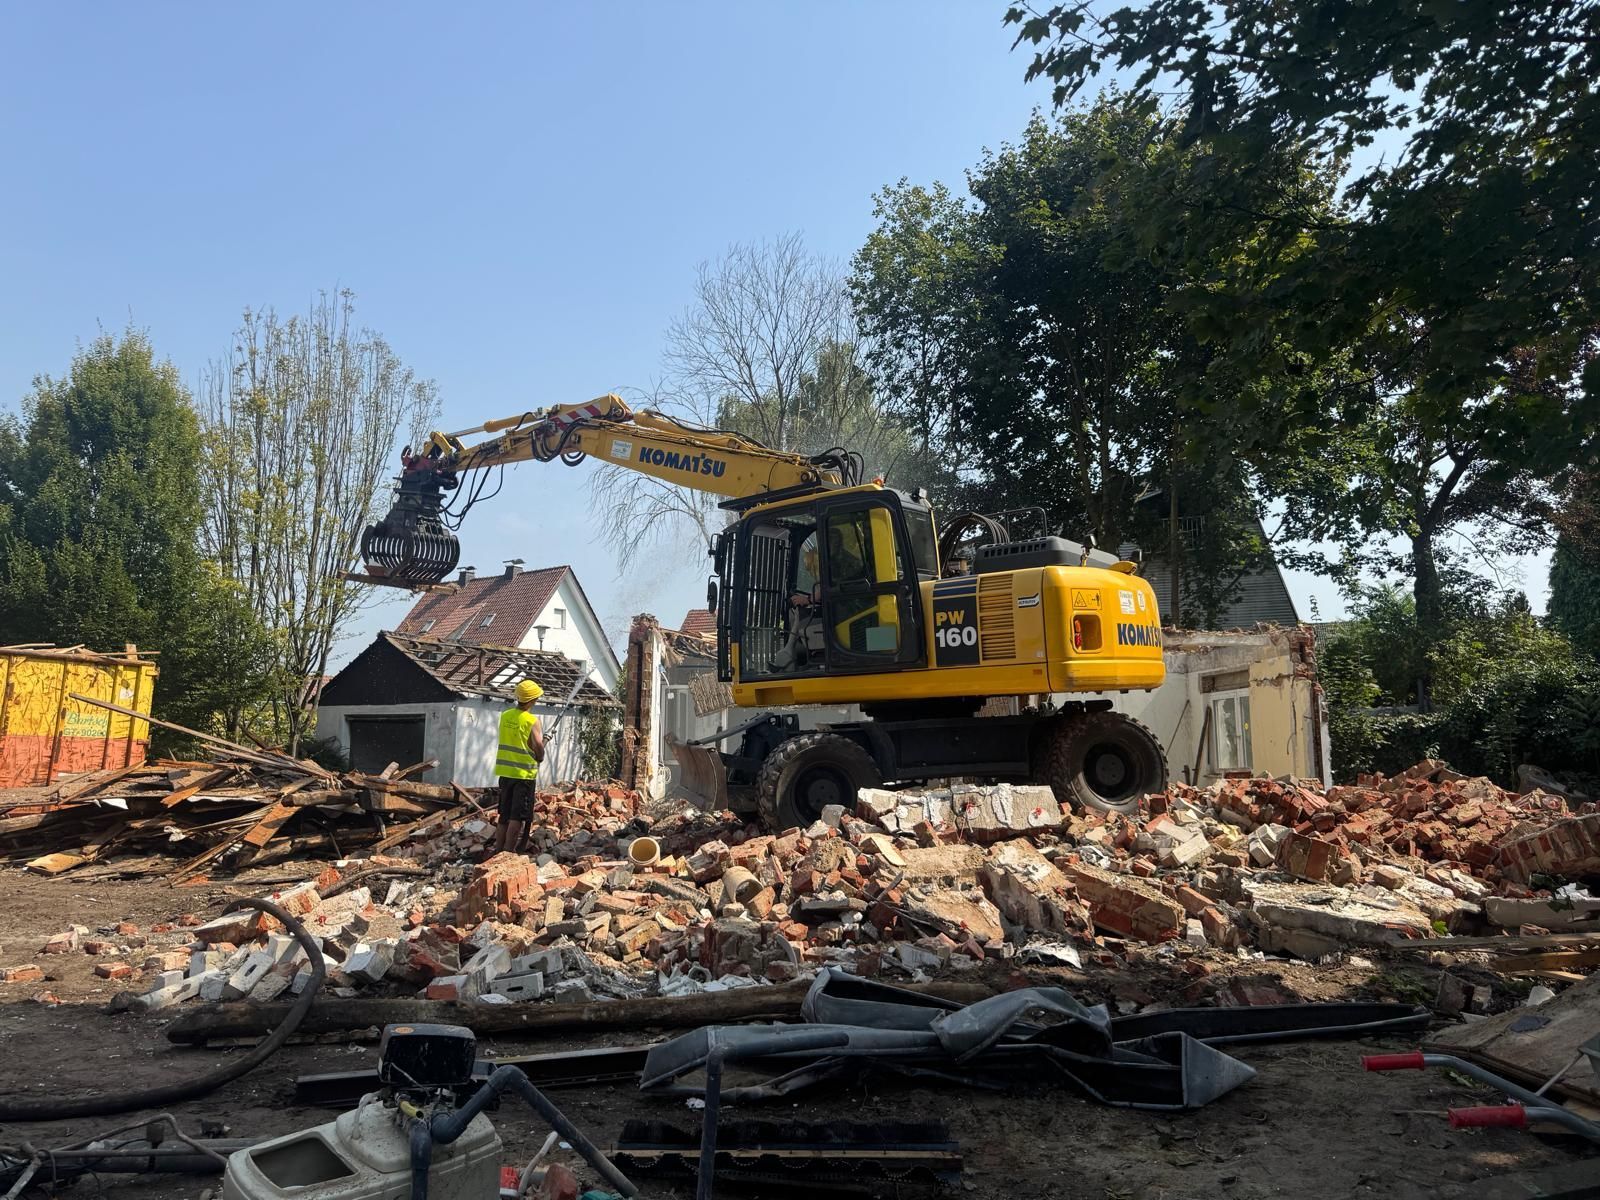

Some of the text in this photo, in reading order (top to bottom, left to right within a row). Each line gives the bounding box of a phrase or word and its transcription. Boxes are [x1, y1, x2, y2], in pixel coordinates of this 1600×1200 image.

[639, 446, 726, 477] KOMATSU
[935, 610, 965, 626] PW
[936, 626, 977, 648] 160
